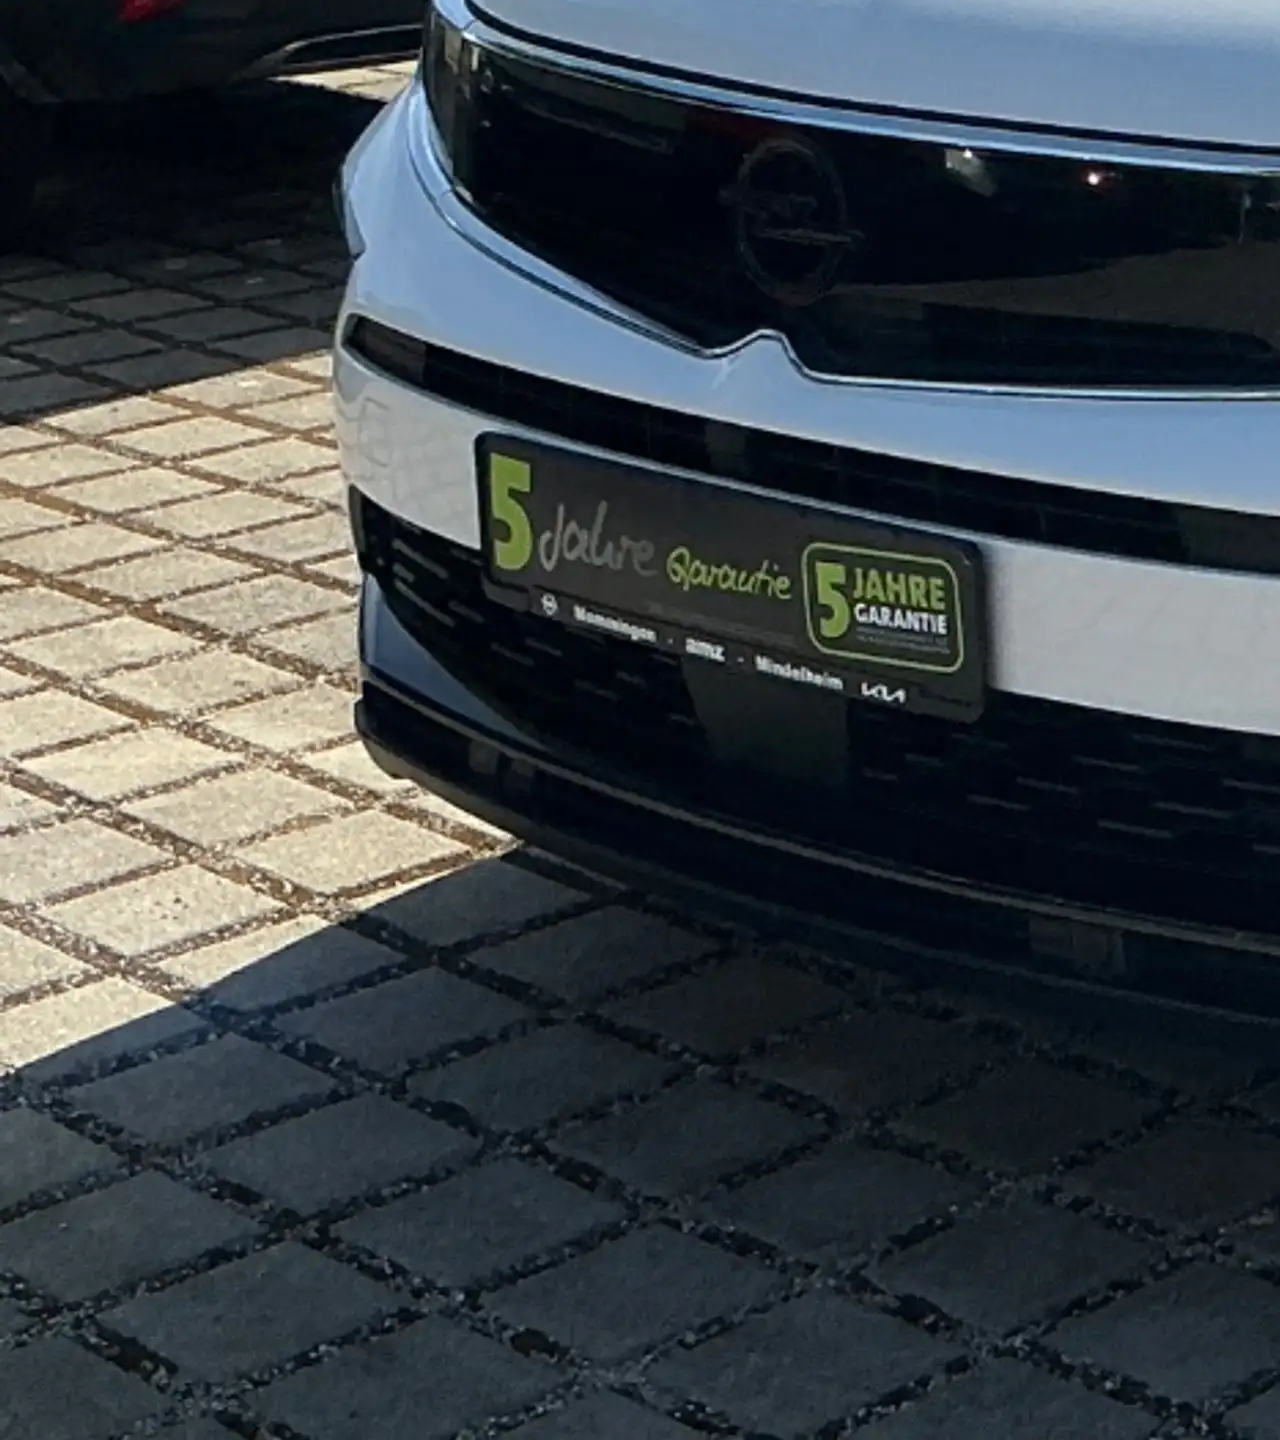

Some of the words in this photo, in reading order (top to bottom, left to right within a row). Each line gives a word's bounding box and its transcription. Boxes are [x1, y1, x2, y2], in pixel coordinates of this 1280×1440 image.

[490, 452, 533, 571] 5
[538, 500, 659, 576] Jahre
[666, 545, 793, 600] Garantie
[815, 560, 850, 638] 5
[853, 568, 946, 611] JAHRE
[854, 603, 948, 636] GARANTIE
[755, 655, 844, 691] Mindelheim
